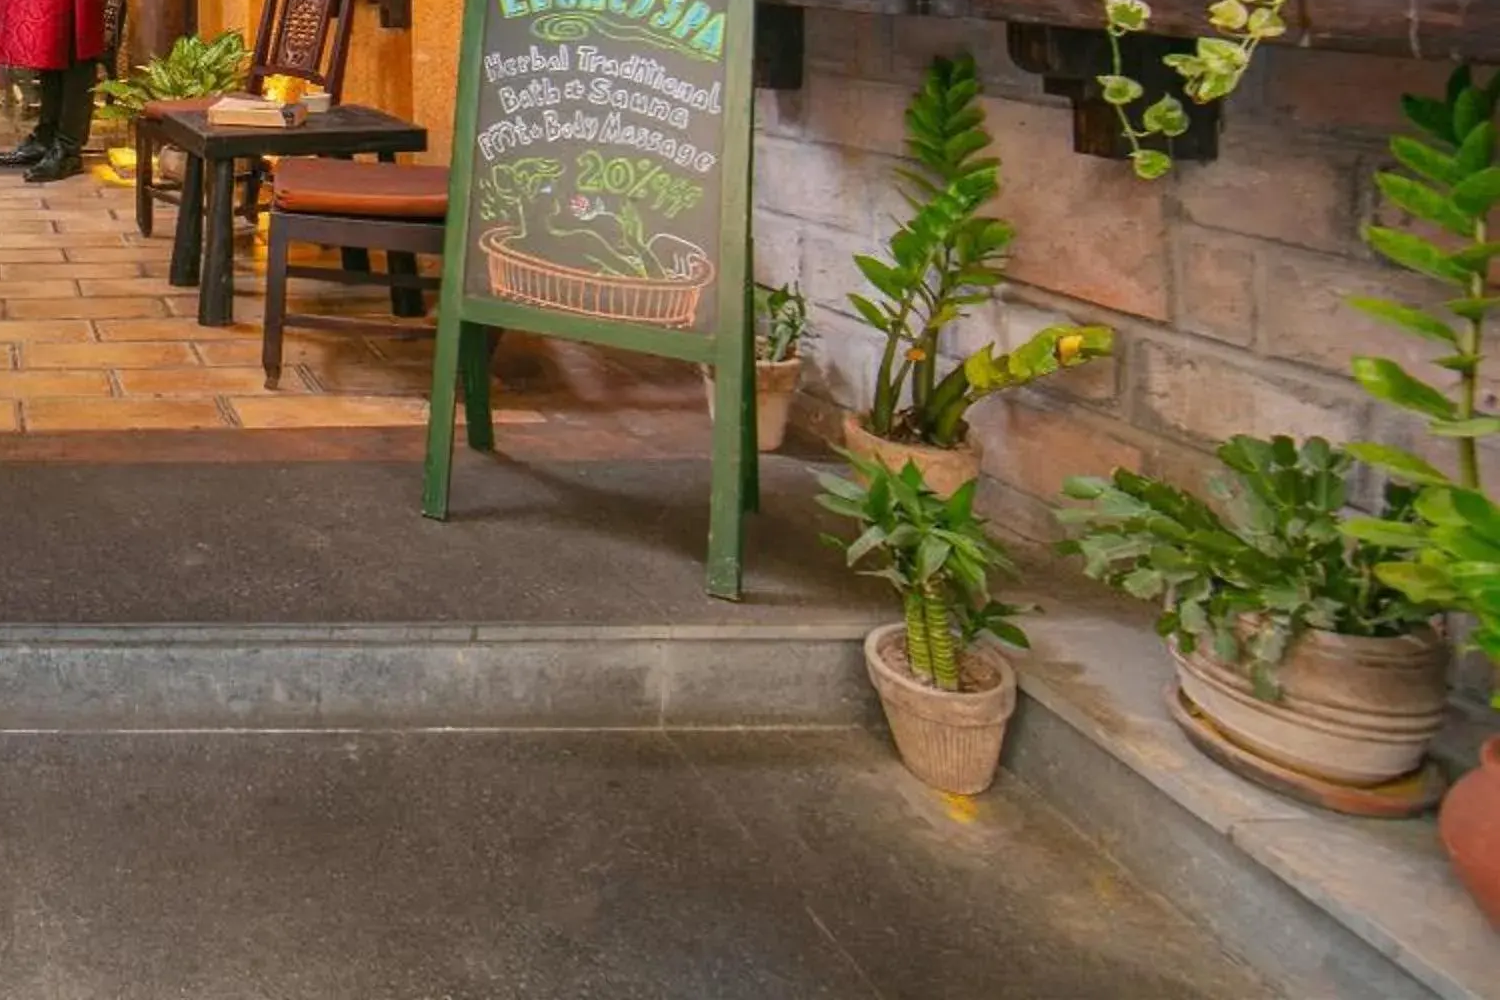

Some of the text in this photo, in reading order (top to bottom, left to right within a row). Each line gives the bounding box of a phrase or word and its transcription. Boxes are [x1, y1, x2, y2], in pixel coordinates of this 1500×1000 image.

[484, 43, 722, 115] Herbal Traditional
[499, 77, 561, 114] Bath
[587, 77, 690, 130] Sauna
[542, 109, 600, 142] Body
[598, 110, 718, 173] Massage
